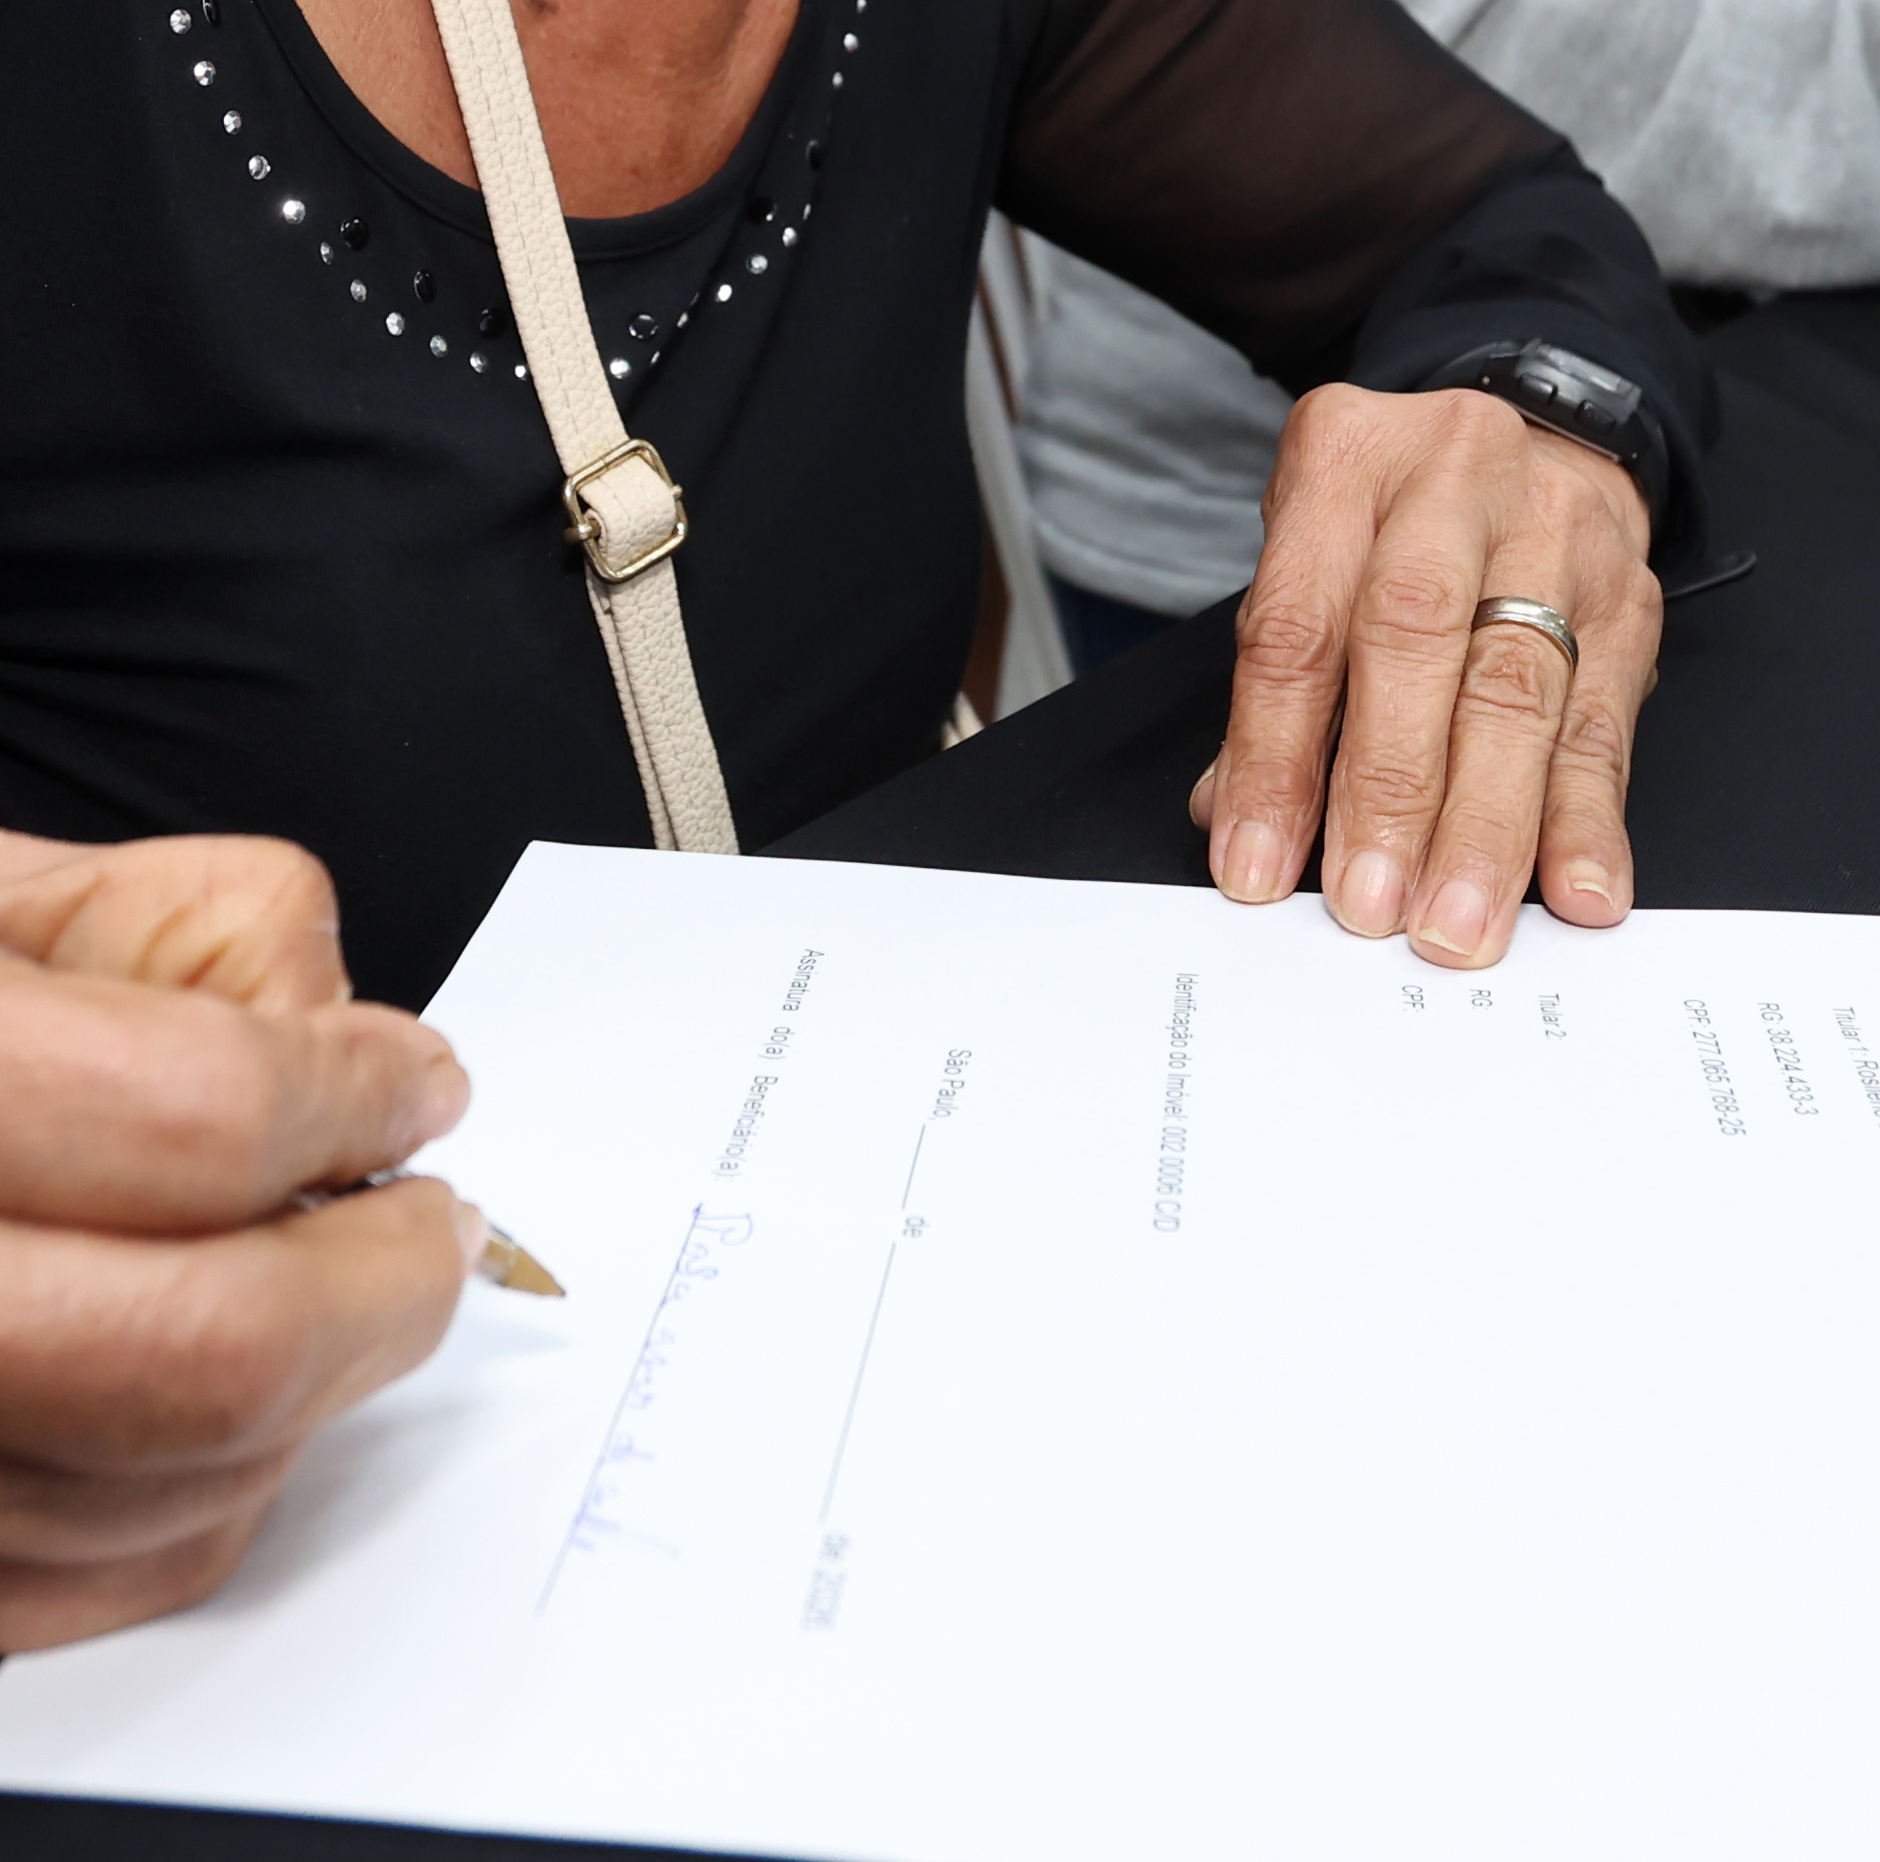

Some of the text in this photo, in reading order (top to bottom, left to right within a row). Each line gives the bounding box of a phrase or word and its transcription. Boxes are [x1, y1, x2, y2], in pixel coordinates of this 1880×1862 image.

[782, 949, 824, 1011] Assinatura
[1166, 973, 1199, 1048] Identificação
[1402, 985, 1424, 1011] CPF:
[1470, 989, 1493, 1009] RG:
[1539, 993, 1562, 1027] Titular
[1684, 1000, 1711, 1029] CPF:
[1833, 1007, 1861, 1042] Titular
[758, 1027, 795, 1059] do(a)
[944, 1049, 972, 1075] São
[1168, 1052, 1192, 1069] do
[1758, 1003, 1819, 1115] RG: 38.224.433-3
[902, 1215, 930, 1238] de
